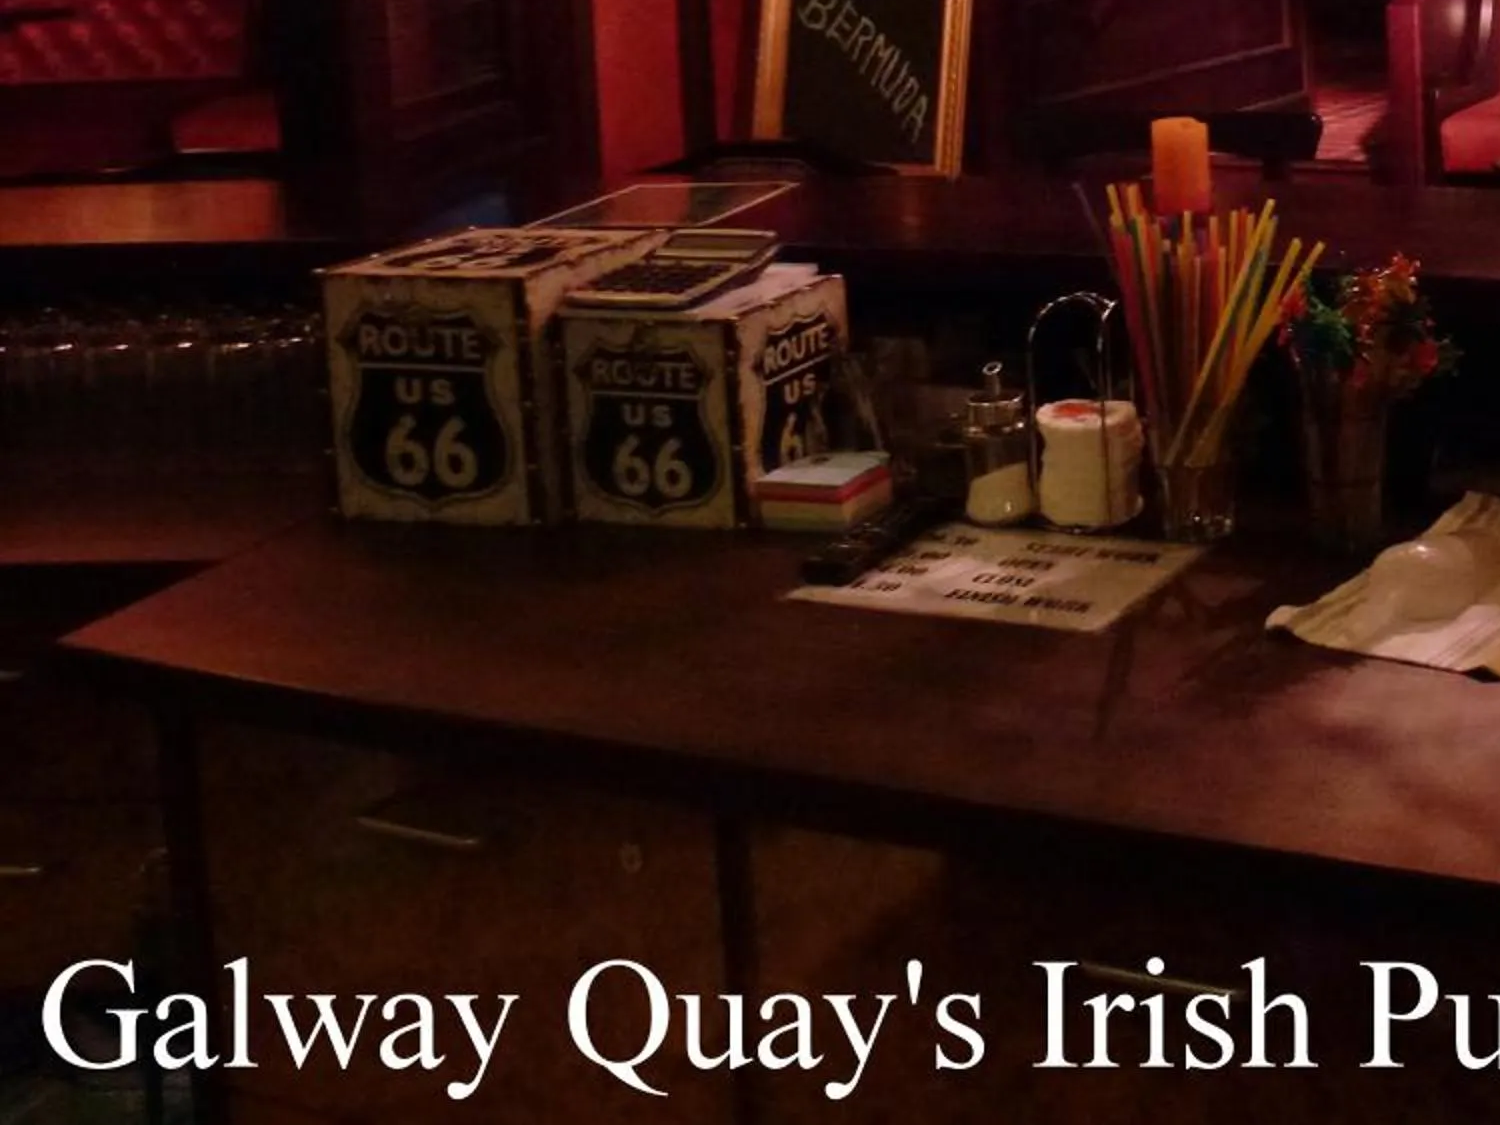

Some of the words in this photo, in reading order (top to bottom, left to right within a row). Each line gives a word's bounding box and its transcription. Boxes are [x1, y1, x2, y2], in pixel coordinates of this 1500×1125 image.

[358, 324, 482, 361] ROUTE
[763, 322, 831, 374] ROUTE
[589, 357, 697, 390] ROUTE
[384, 413, 480, 490] 66
[611, 432, 693, 499] 66
